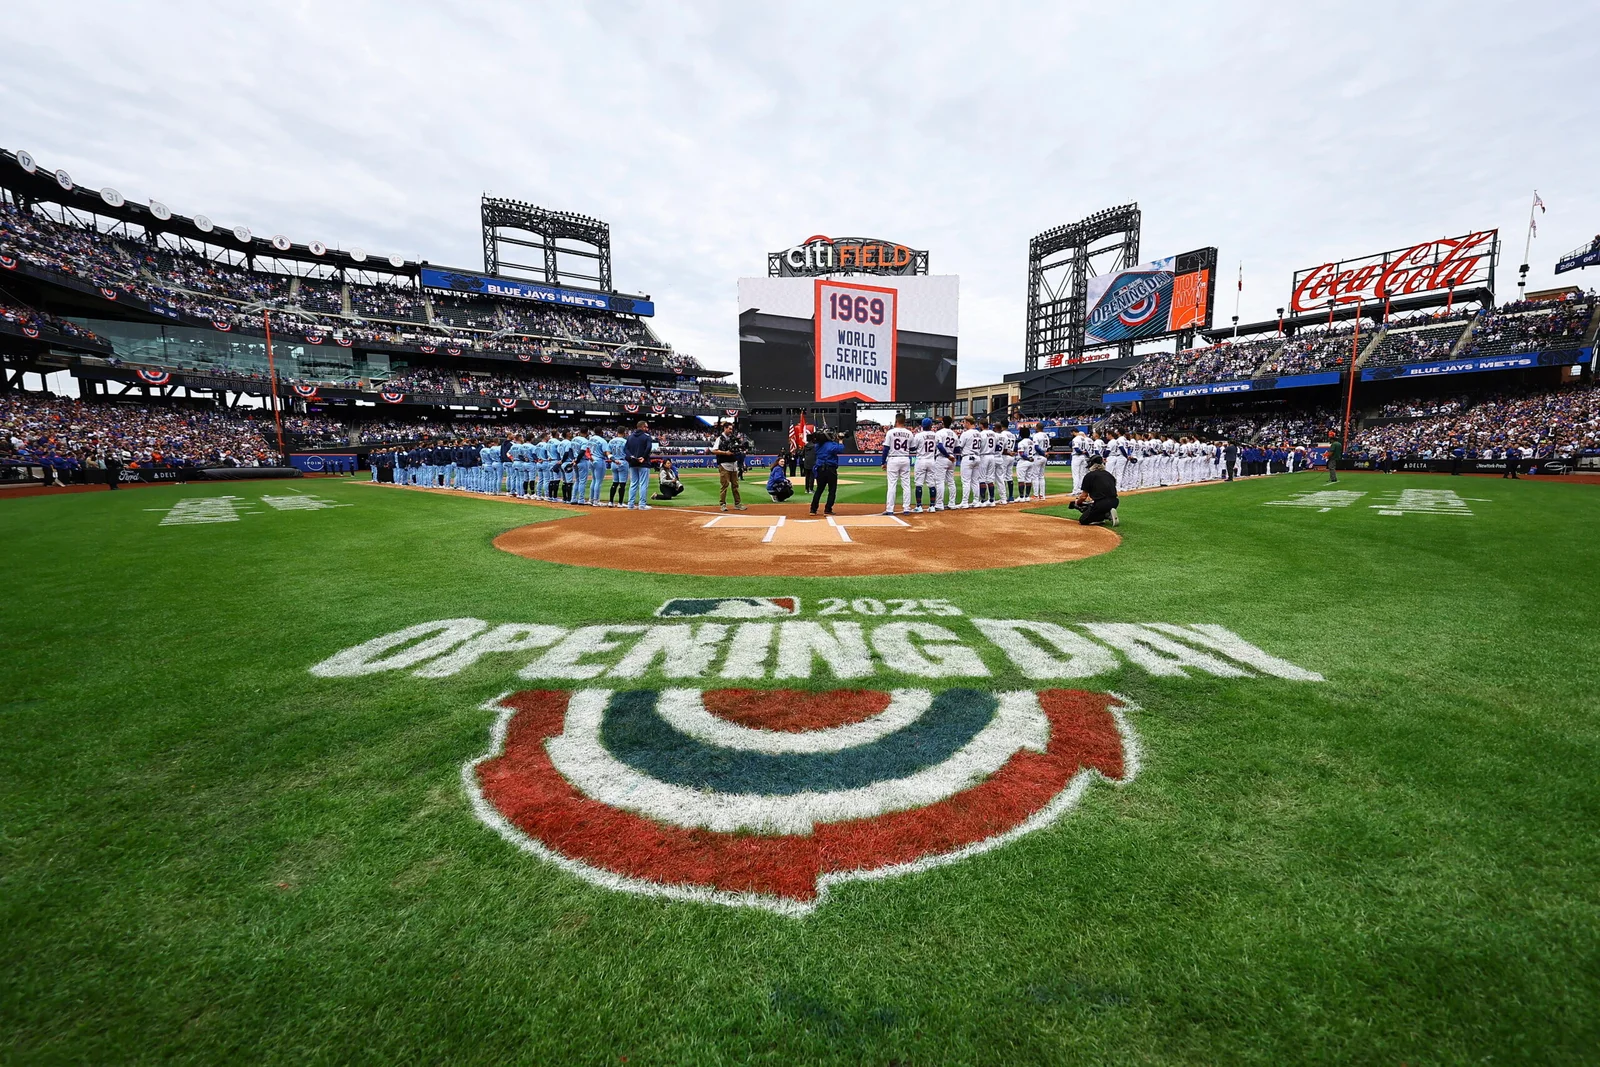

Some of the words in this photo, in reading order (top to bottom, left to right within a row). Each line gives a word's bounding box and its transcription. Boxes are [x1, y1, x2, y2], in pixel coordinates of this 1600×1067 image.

[22, 155, 31, 166] 17
[60, 174, 70, 186] 36
[107, 192, 119, 203] 31
[155, 206, 166, 216] 41
[199, 218, 208, 228] 14
[787, 240, 833, 268] citi
[839, 244, 911, 268] FIELD
[1291, 228, 1498, 313] Coca-Cola
[487, 284, 521, 297] BLUE
[523, 288, 556, 301] JAYS
[561, 295, 607, 308] METS
[1091, 281, 1146, 326] OPENING
[1143, 270, 1172, 293] DAY
[829, 292, 885, 326] 1969
[837, 329, 876, 349] WORLD
[836, 348, 877, 367] SERIES
[1410, 367, 1440, 375] BLUE
[1441, 363, 1474, 373] JAYS
[1479, 358, 1532, 370] METS
[824, 363, 888, 386] CHAMPIONS
[1162, 390, 1184, 398] BLUE
[1185, 387, 1209, 397] JAYS
[1212, 384, 1250, 394] METS
[893, 438, 908, 452] 64
[924, 441, 935, 453] 12
[945, 437, 955, 449] 22
[972, 439, 981, 450] 20
[988, 438, 994, 448] 9
[1028, 446, 1033, 456] 2
[118, 470, 140, 482] Ford
[160, 471, 177, 479] DELT
[817, 597, 963, 616] 2025
[309, 618, 992, 681] OPENING
[971, 618, 1325, 683] DAY
